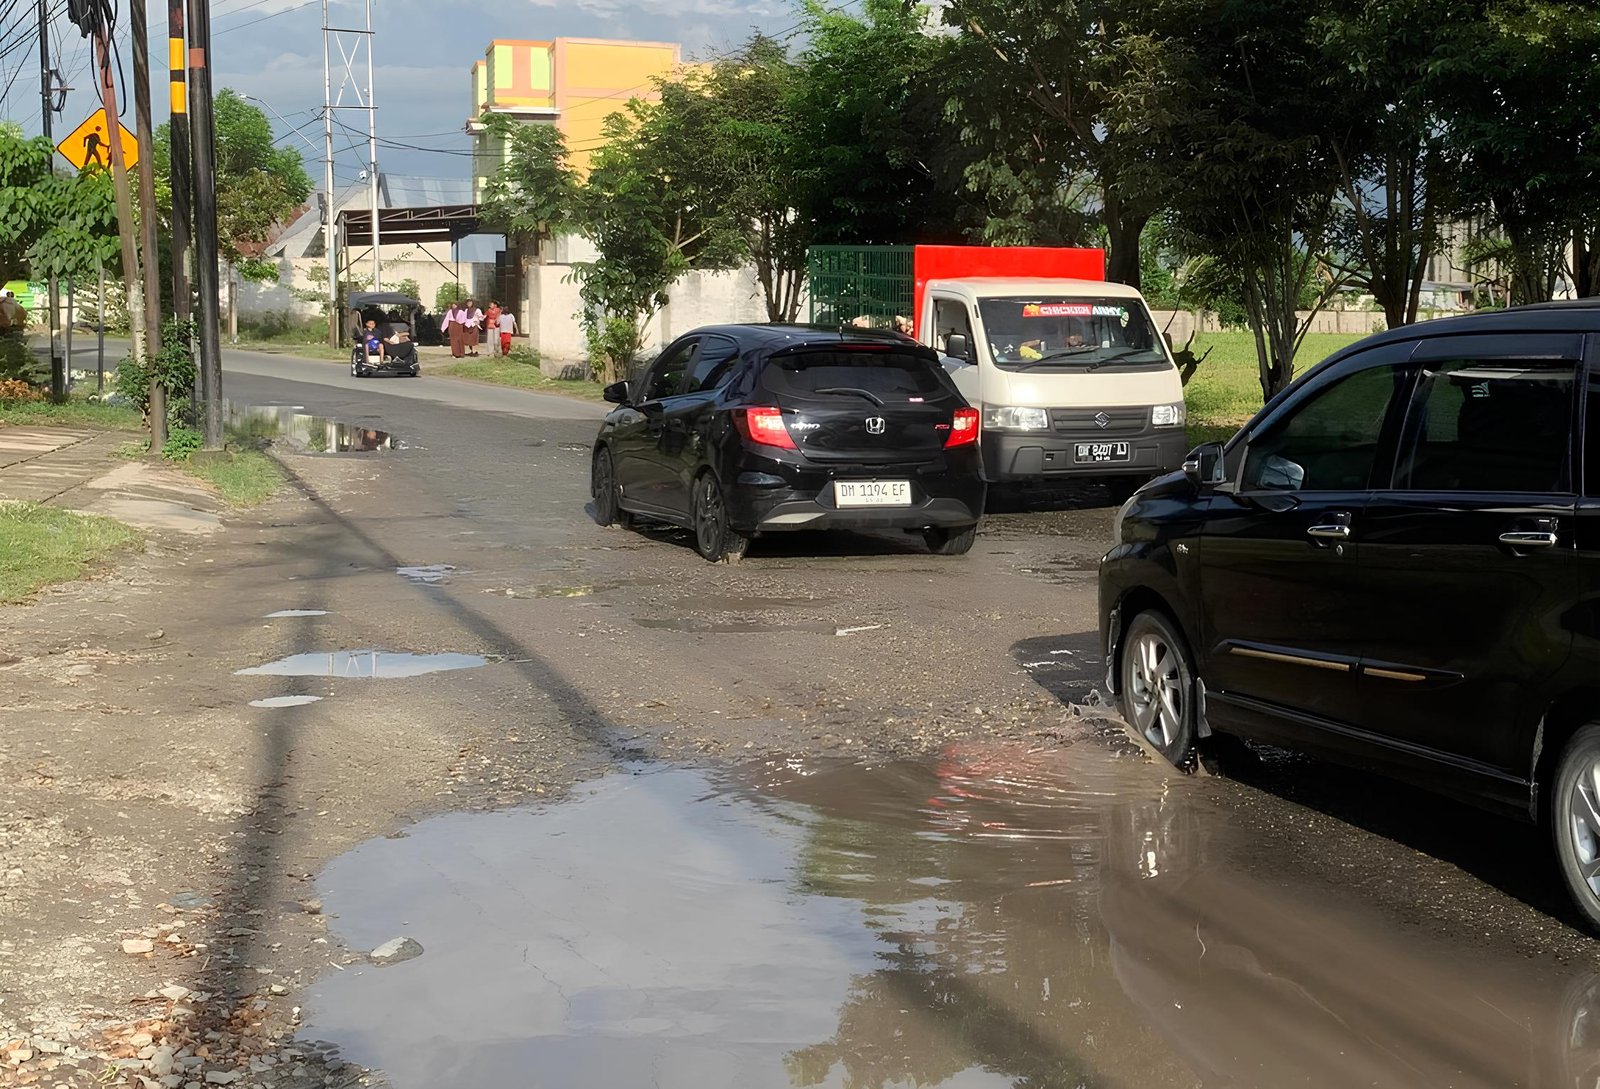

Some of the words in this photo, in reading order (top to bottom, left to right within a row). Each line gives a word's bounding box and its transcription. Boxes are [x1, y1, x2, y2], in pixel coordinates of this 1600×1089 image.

[1092, 305, 1121, 315] ARMY
[841, 485, 855, 497] DM
[860, 484, 888, 497] 1194
[892, 483, 906, 496] EF
